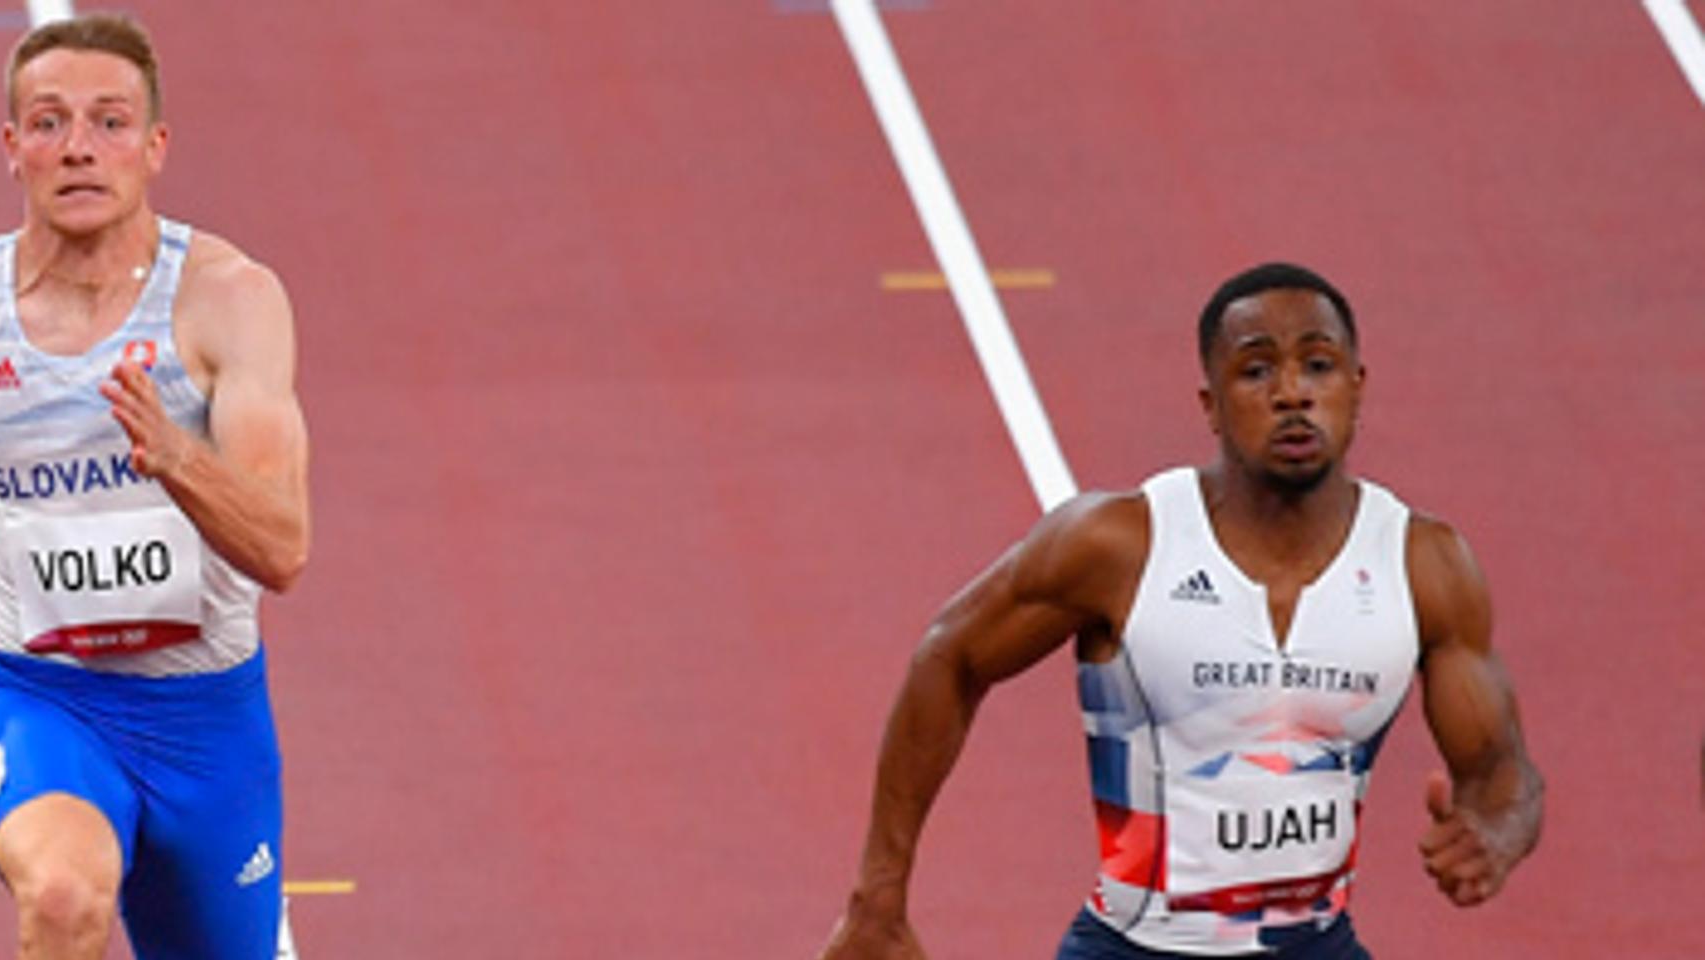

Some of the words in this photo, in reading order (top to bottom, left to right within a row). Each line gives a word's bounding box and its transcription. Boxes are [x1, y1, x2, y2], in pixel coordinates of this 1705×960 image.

[30, 540, 172, 591] VOLKO
[1193, 662, 1272, 688] GREAT
[1281, 662, 1379, 693] BRITAIN
[1216, 800, 1337, 852] UJAH
